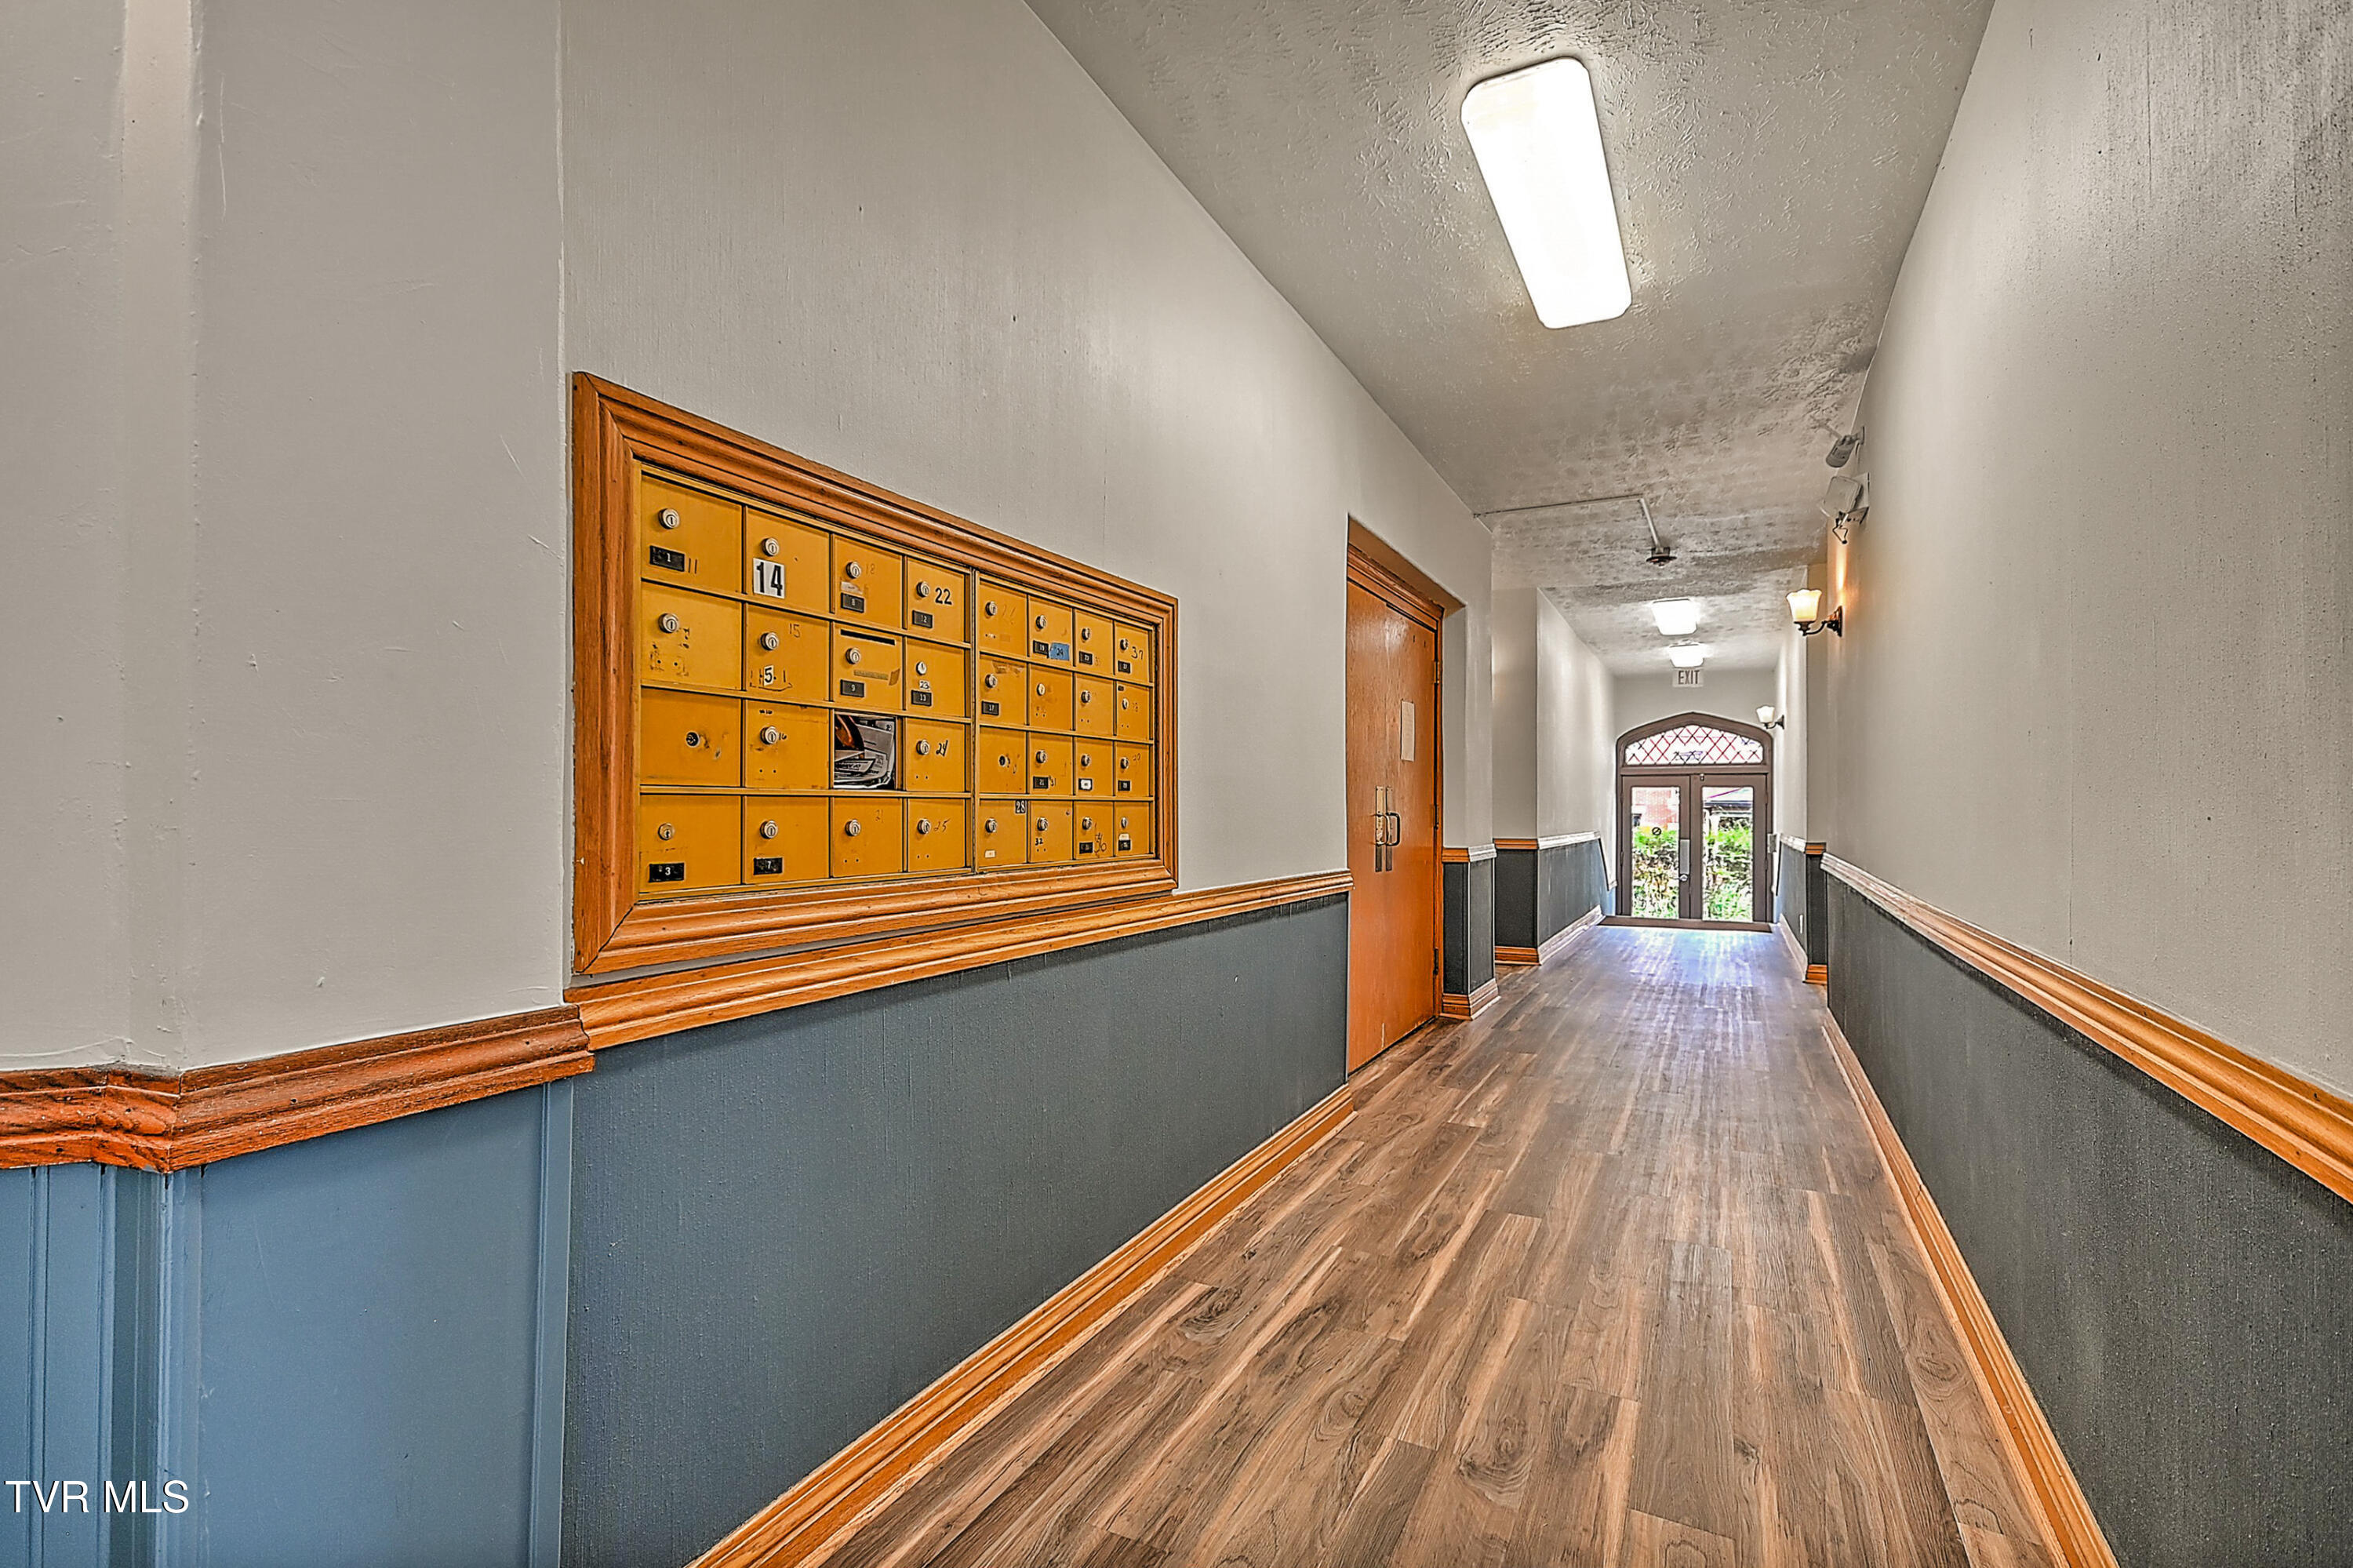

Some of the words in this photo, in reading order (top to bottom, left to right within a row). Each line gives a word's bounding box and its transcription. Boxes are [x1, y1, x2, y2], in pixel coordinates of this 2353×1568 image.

[666, 553, 671, 562] 1
[755, 562, 783, 596] 14
[935, 587, 952, 605] 22
[789, 623, 801, 638] 15
[1131, 646, 1144, 660] 37
[764, 667, 773, 683] 5
[1678, 670, 1700, 684] EXIT
[919, 681, 929, 689] 23
[1016, 800, 1026, 813] 28
[933, 818, 950, 831] 25
[664, 867, 671, 875] 3
